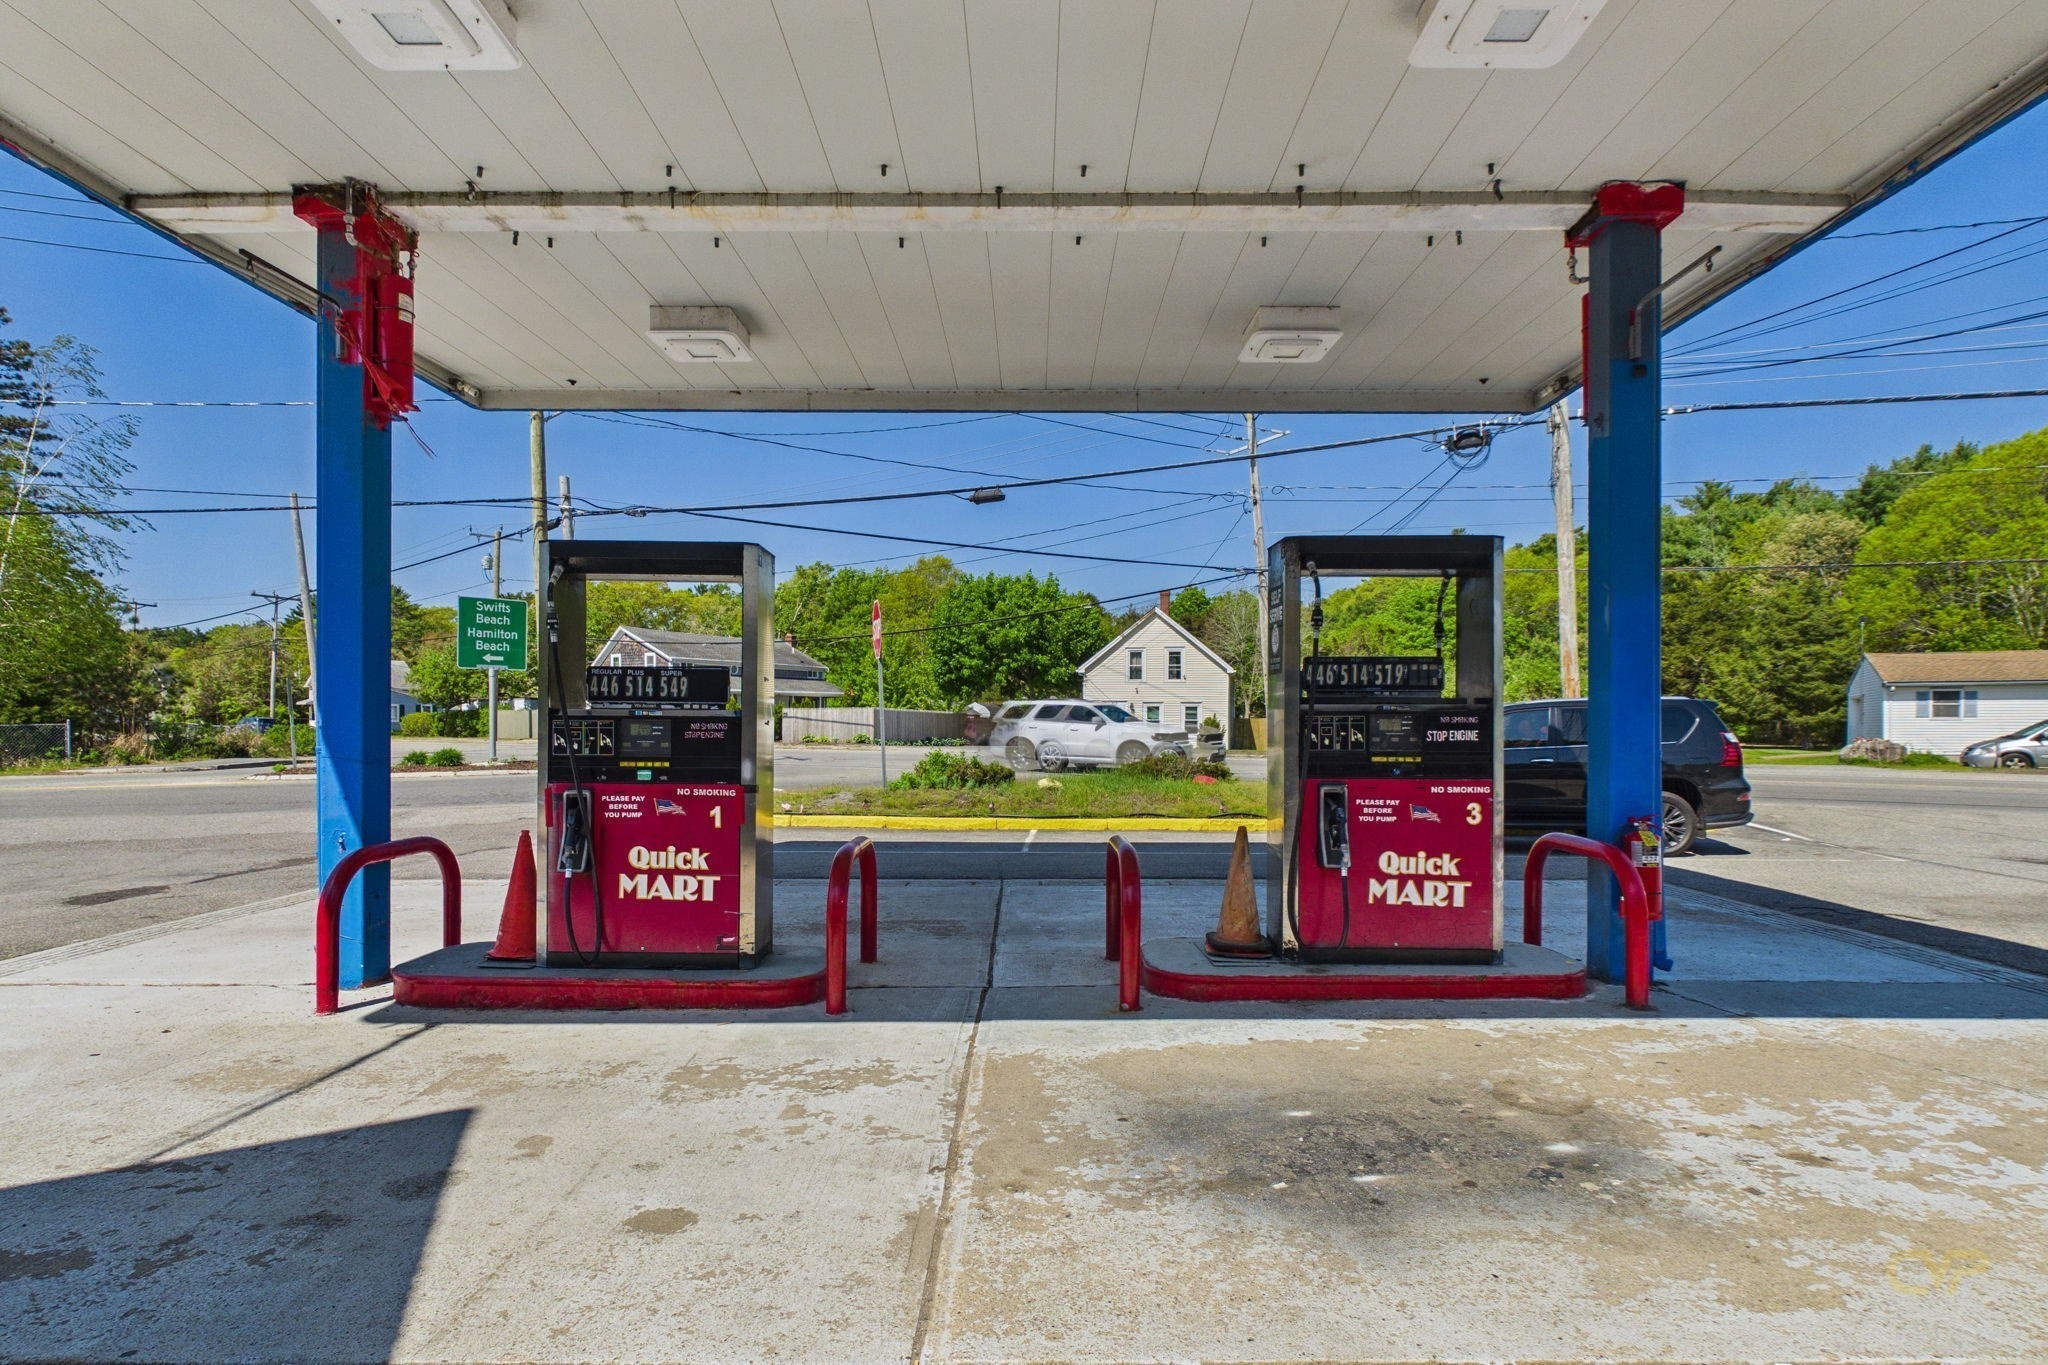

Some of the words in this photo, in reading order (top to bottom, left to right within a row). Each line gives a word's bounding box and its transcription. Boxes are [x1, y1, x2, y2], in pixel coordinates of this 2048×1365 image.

[476, 601, 511, 613] Swifts
[476, 613, 511, 625] Beach
[467, 627, 518, 640] Hamilton
[475, 640, 510, 652] Beach
[590, 675, 619, 696] 446
[625, 676, 653, 697] 514
[660, 676, 688, 697] 549
[1426, 730, 1448, 742] STOP
[1449, 730, 1479, 741] ENGINE
[677, 788, 691, 796] NO
[693, 788, 736, 797] SMOKING
[1430, 786, 1445, 794] NO
[1447, 786, 1491, 794] SMOKING
[709, 805, 722, 829] 1
[1466, 802, 1483, 826] 3
[627, 845, 710, 871] Quick
[1378, 850, 1461, 876] Quick
[618, 873, 721, 901] MART
[1368, 878, 1472, 907] MART
